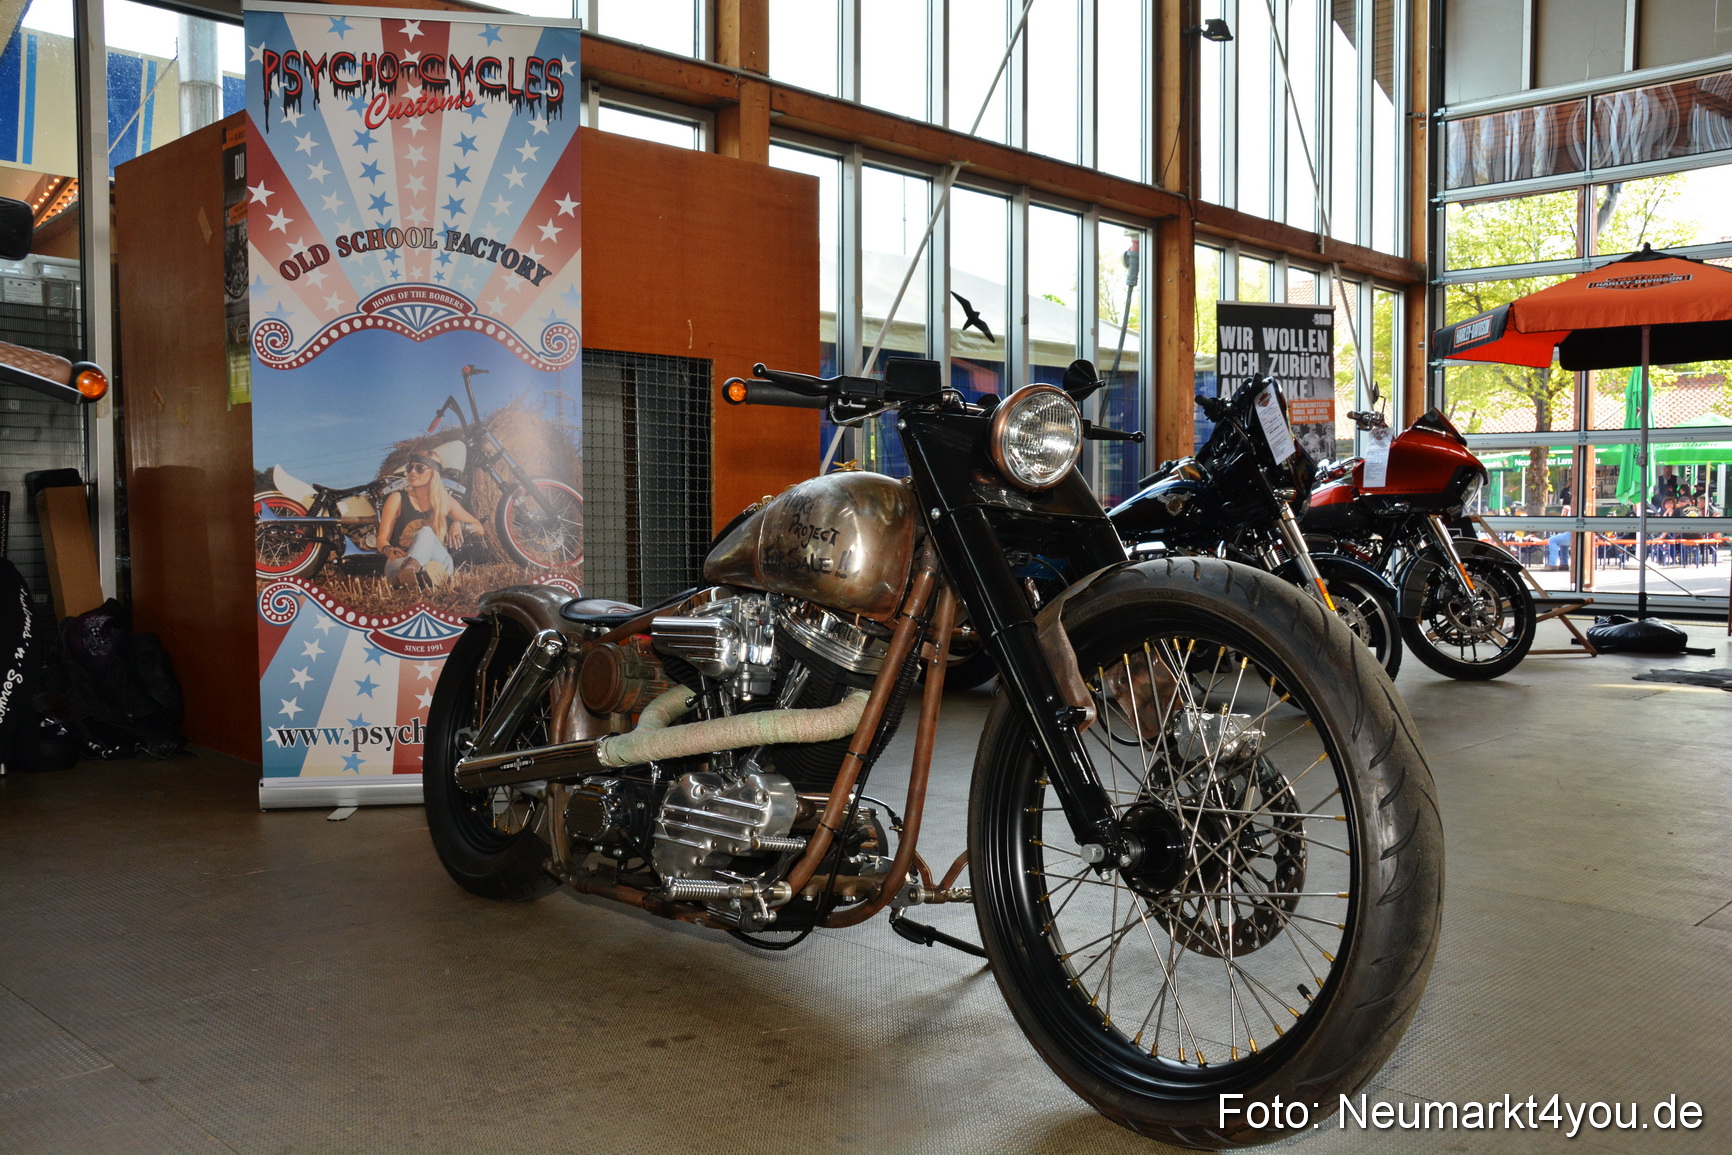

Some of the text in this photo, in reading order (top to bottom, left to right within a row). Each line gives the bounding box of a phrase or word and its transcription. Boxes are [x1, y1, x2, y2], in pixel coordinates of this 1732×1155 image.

[262, 48, 566, 125] PSYCHO-CYCLES
[365, 89, 476, 130] Customs
[279, 226, 552, 287] OLD SCHOOL FACTORY
[1595, 276, 1684, 288] HARLEY-DAVIDSON
[371, 290, 465, 310] HOME OF THE BOBBERS
[1219, 325, 1328, 353] WIR WOLLEN
[1220, 351, 1331, 379] DICH ZURÜCK
[788, 513, 841, 549] PROJECT
[787, 546, 832, 575] SALE
[404, 643, 444, 653] SINCE 1991
